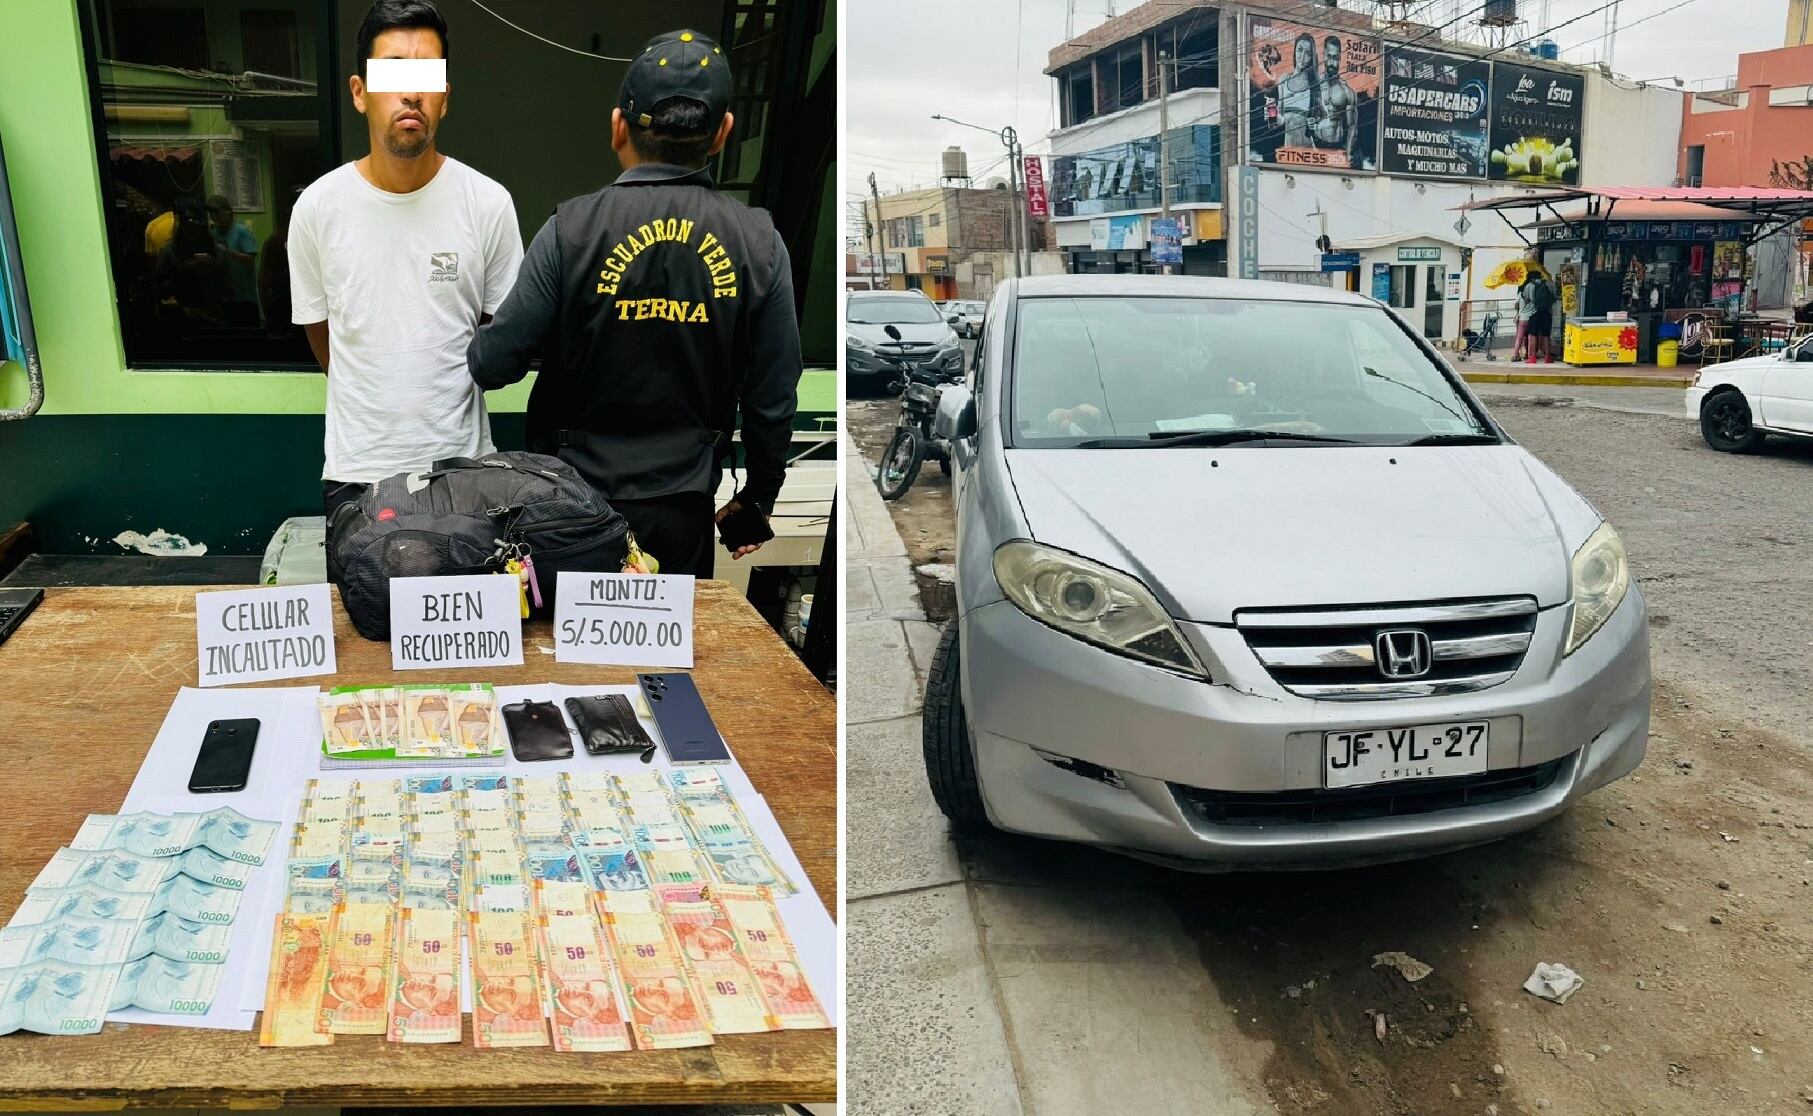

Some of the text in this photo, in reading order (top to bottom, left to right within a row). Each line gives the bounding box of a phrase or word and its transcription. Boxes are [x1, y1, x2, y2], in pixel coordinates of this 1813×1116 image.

[1388, 84, 1479, 112] USAPERCARS
[1390, 105, 1454, 122] IMPORTACIONES
[1397, 143, 1458, 159] MAQUINARIAS
[1416, 160, 1447, 173] MUCHO
[1024, 158, 1045, 213] HOSTAL
[597, 218, 737, 299] ESCUADRON VERDE
[615, 298, 709, 323] TERNA
[590, 578, 666, 602] MONTO:
[421, 591, 483, 623] BIEN
[221, 598, 310, 634] CELULAR
[561, 619, 683, 648] S/.5.000.00
[400, 630, 511, 663] RECUPERADO
[205, 634, 326, 677] INCAUTADO
[1381, 766, 1434, 779] CHILE
[152, 845, 182, 856] 10000
[231, 850, 261, 864] 10000
[211, 874, 243, 888] 10000
[197, 911, 230, 922] 10000
[354, 933, 372, 946] 50
[746, 929, 767, 942] 50
[422, 940, 441, 954] 50
[494, 942, 514, 956] 50
[565, 946, 586, 960] 50
[635, 944, 657, 958] 50
[186, 950, 221, 962] 10000
[169, 999, 206, 1012] 10000
[58, 1018, 97, 1032] 10000
